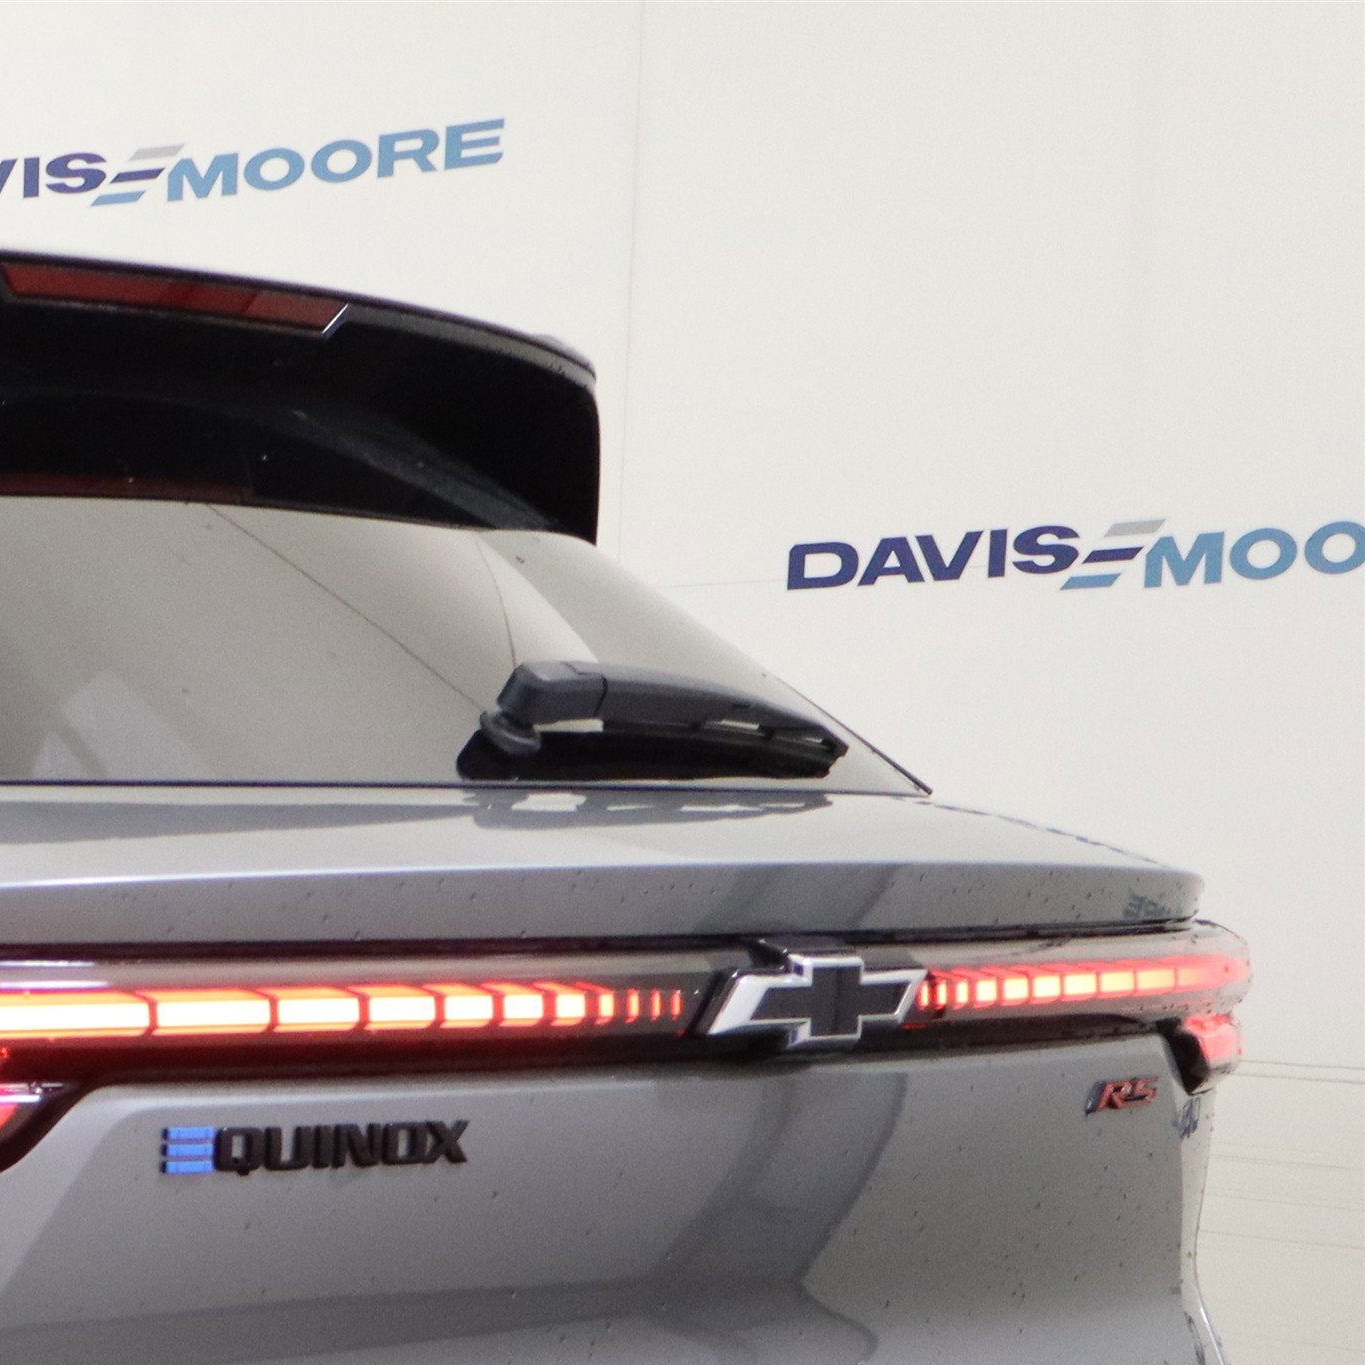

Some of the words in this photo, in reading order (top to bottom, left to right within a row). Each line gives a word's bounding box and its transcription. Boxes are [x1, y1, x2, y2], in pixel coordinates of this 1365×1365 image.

[167, 118, 505, 203] MOORE
[786, 525, 1079, 590] DAVIS
[1086, 1076, 1159, 1115] RS
[160, 1119, 470, 1176] EQUINOX
